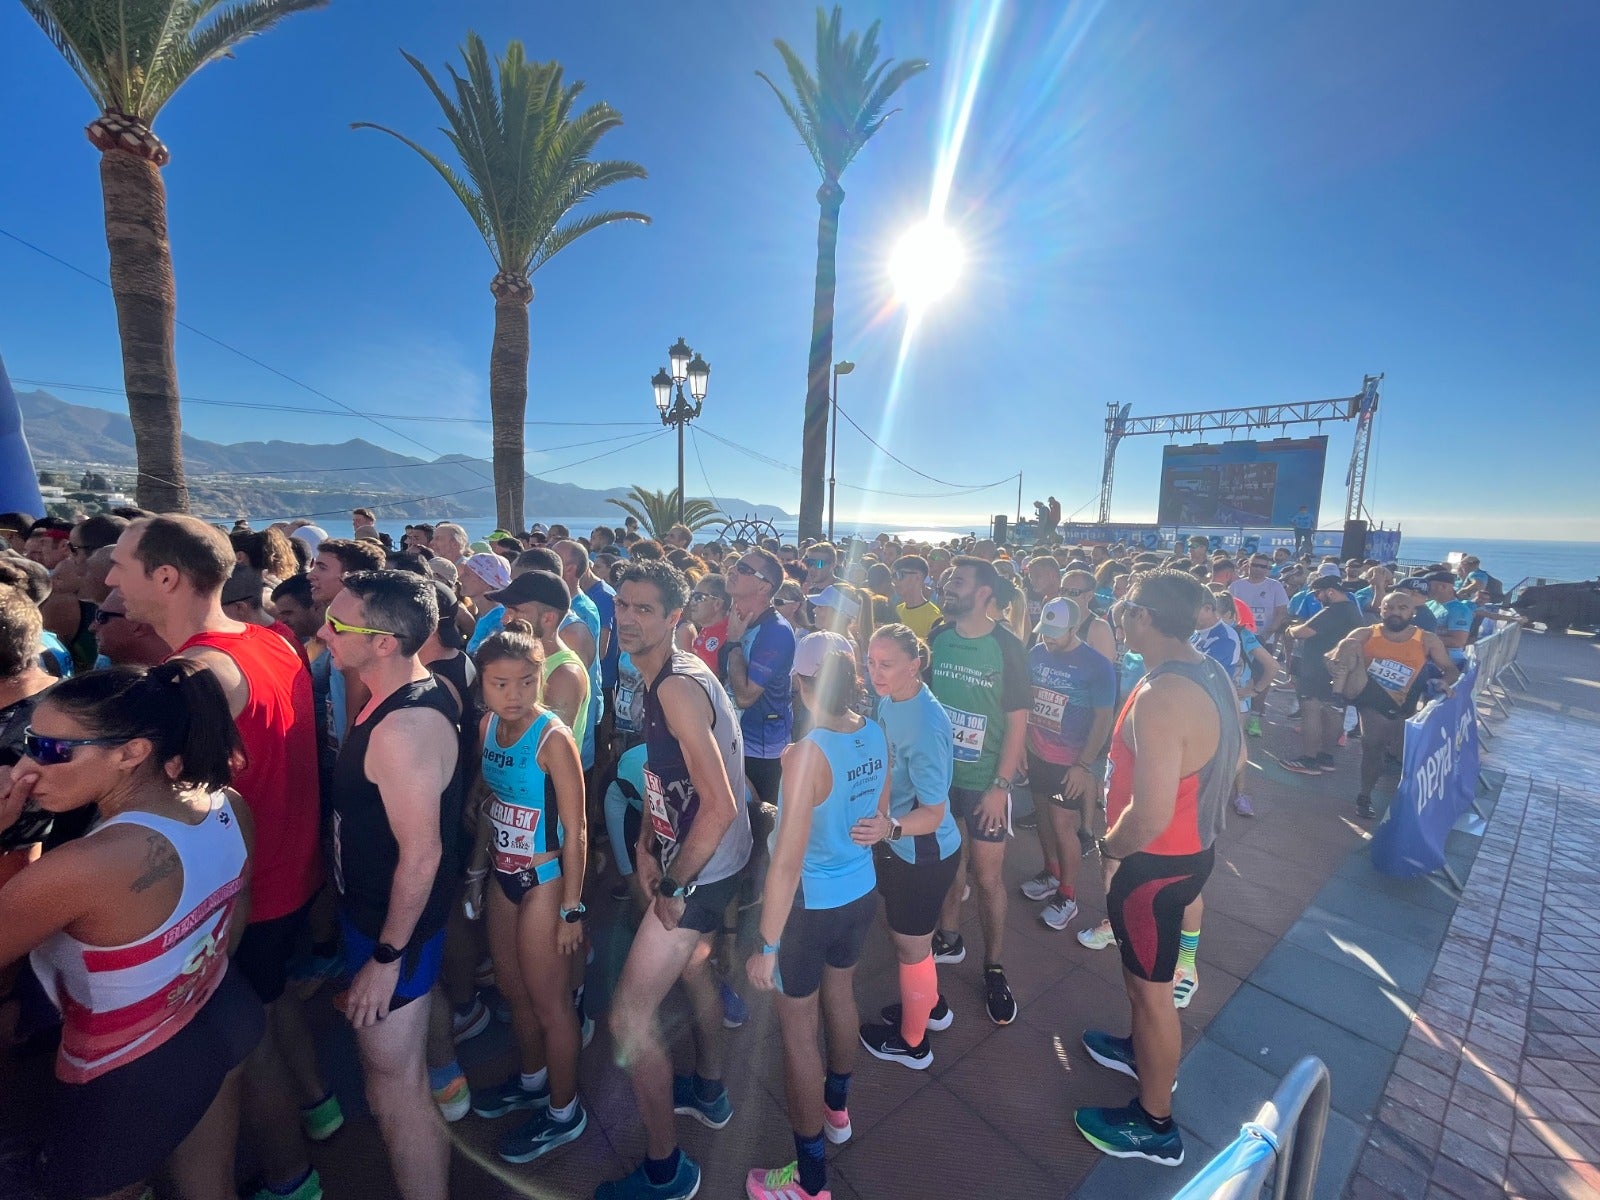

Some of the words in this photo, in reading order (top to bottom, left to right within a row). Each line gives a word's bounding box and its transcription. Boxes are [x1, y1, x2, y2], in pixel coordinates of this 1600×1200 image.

[967, 716, 984, 730] 10K
[483, 747, 514, 768] nerja
[847, 757, 882, 781] nerja
[1417, 726, 1452, 816] nerja
[490, 800, 514, 825] NERJA
[516, 810, 534, 830] 5K
